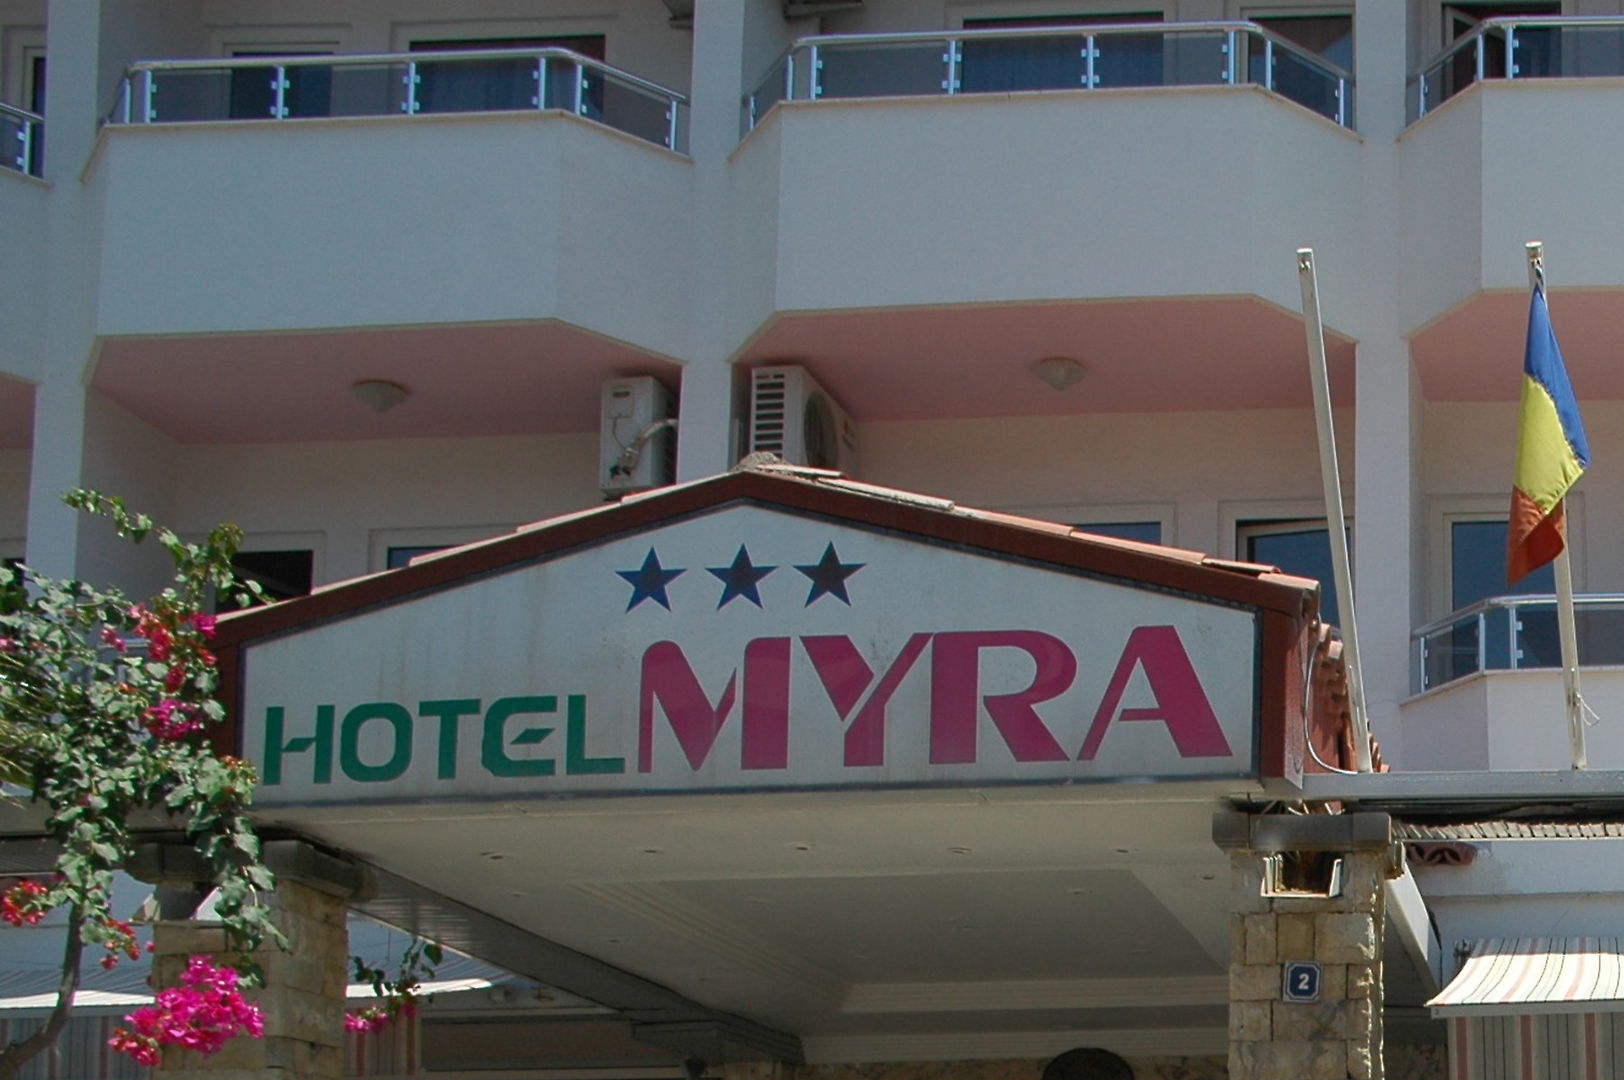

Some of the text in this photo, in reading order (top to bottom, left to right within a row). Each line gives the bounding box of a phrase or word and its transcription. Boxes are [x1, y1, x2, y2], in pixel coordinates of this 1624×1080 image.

[261, 625, 1234, 786] HOTEL MYRA
[1298, 973, 1309, 990] 2
